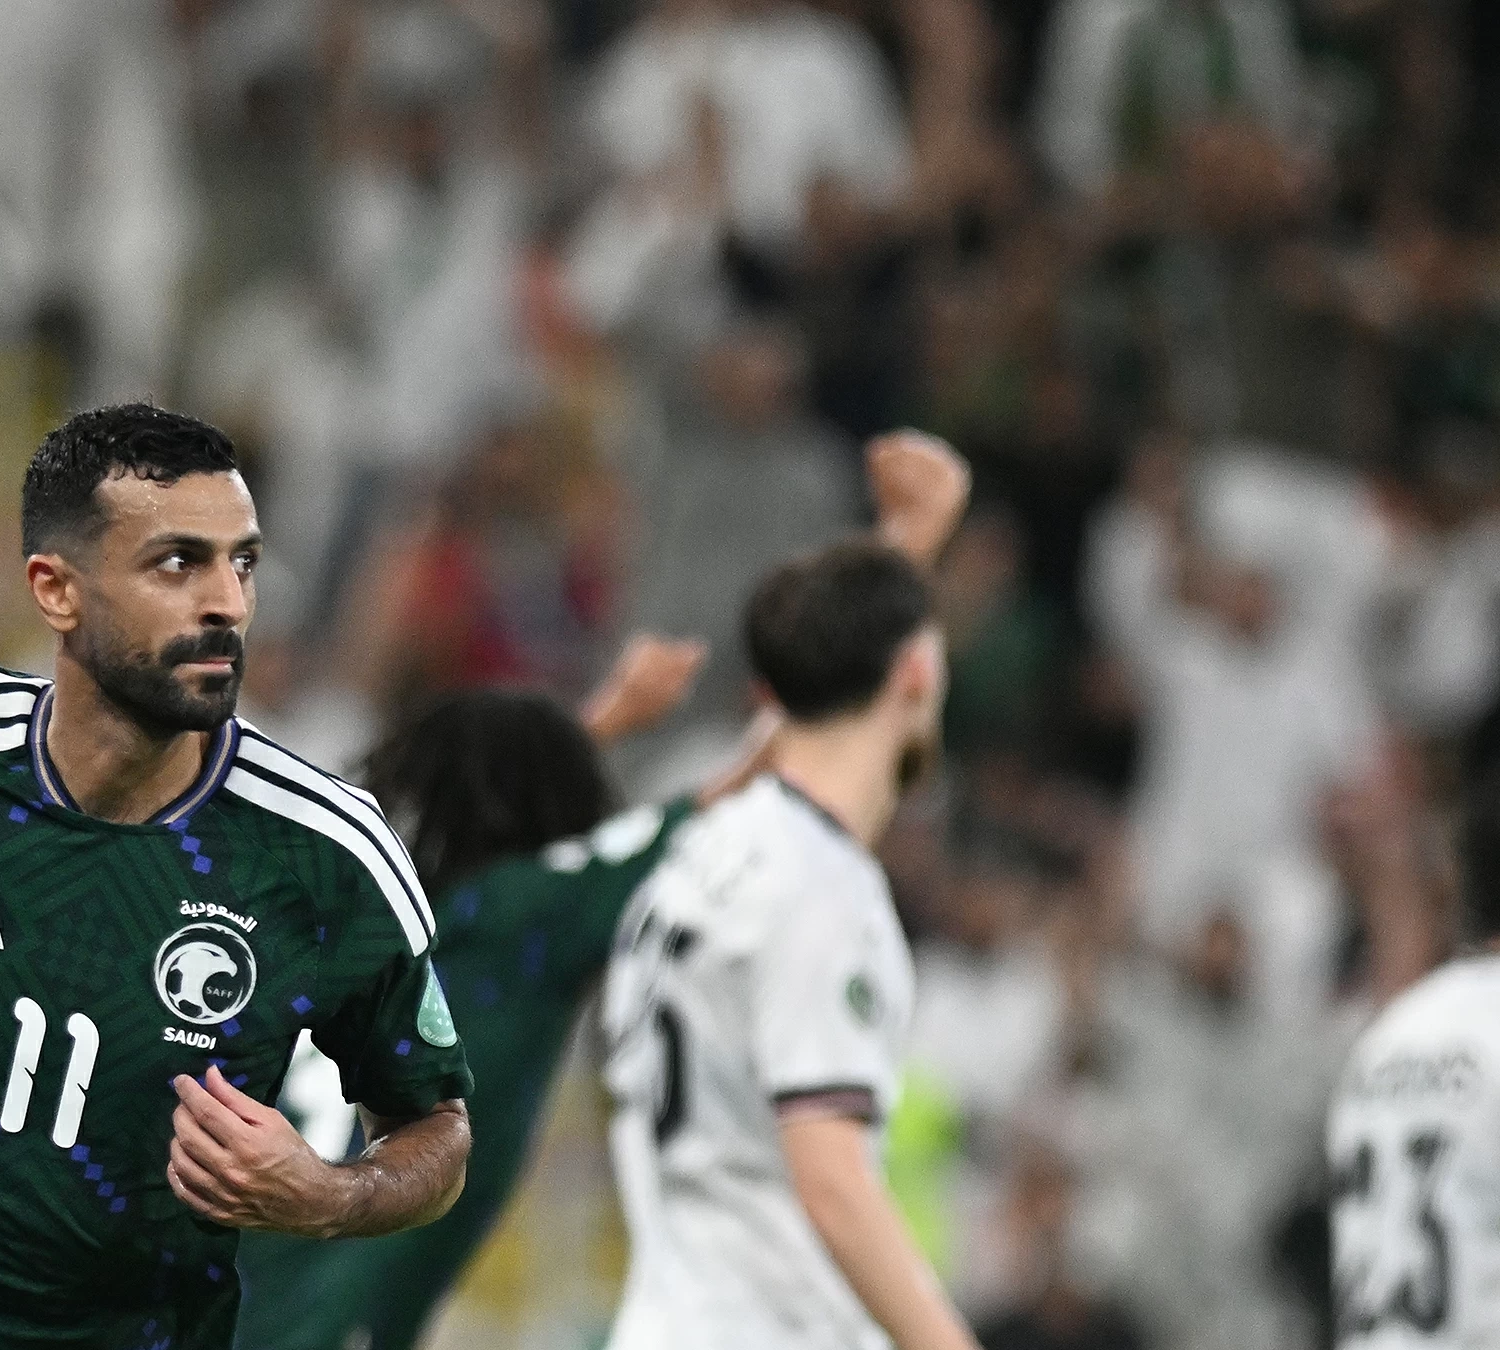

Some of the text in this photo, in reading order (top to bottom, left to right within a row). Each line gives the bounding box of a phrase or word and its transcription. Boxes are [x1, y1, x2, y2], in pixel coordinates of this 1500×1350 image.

[179, 900, 258, 933] السعودية
[205, 986, 234, 999] SAFF
[163, 1027, 217, 1050] SAUDI
[1, 997, 100, 1149] 11
